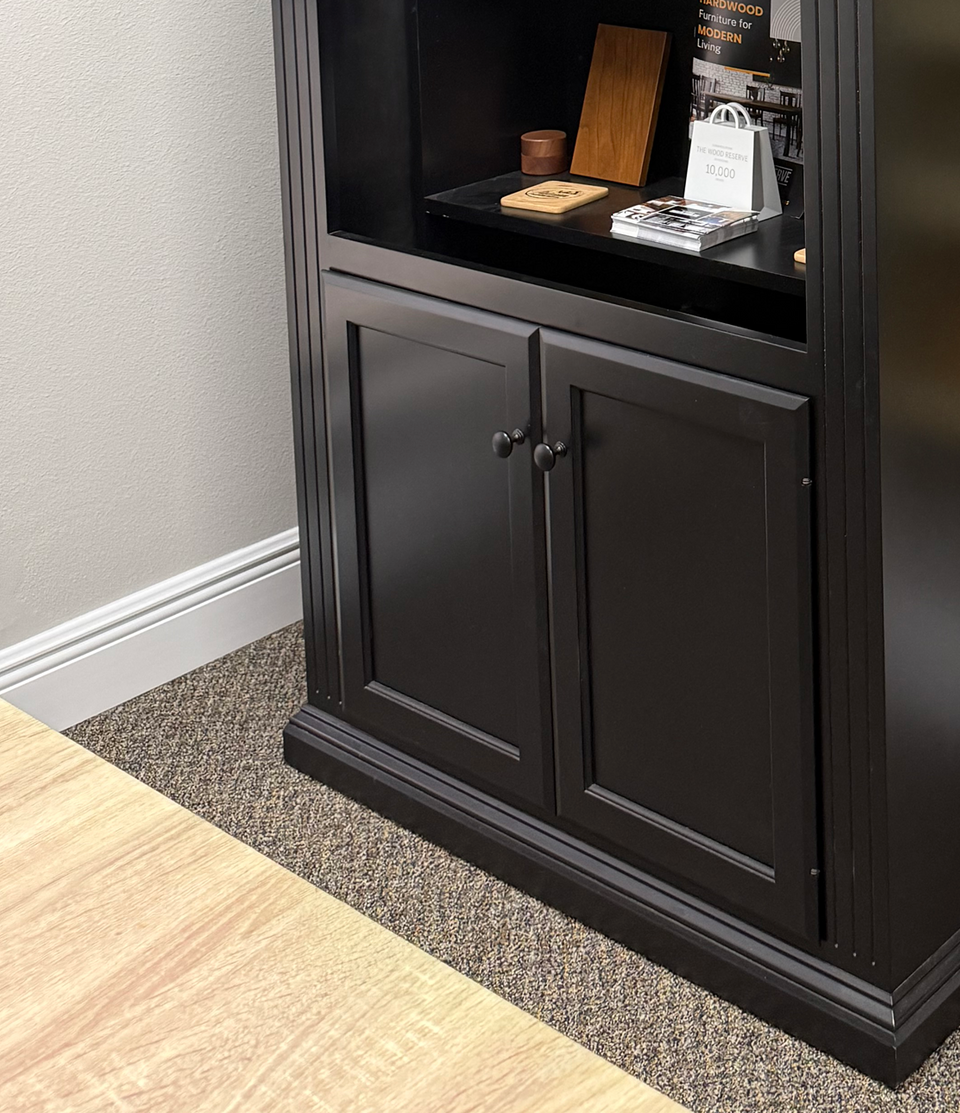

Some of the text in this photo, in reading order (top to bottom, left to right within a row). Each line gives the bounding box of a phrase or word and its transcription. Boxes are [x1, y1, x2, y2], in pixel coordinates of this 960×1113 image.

[699, 9, 752, 30] Furniture for
[698, 24, 742, 44] MODERN
[697, 38, 722, 55] Living
[696, 145, 706, 154] THE
[708, 148, 724, 158] WOOD
[725, 151, 748, 163] RESERVE
[705, 164, 736, 179] 10,000
